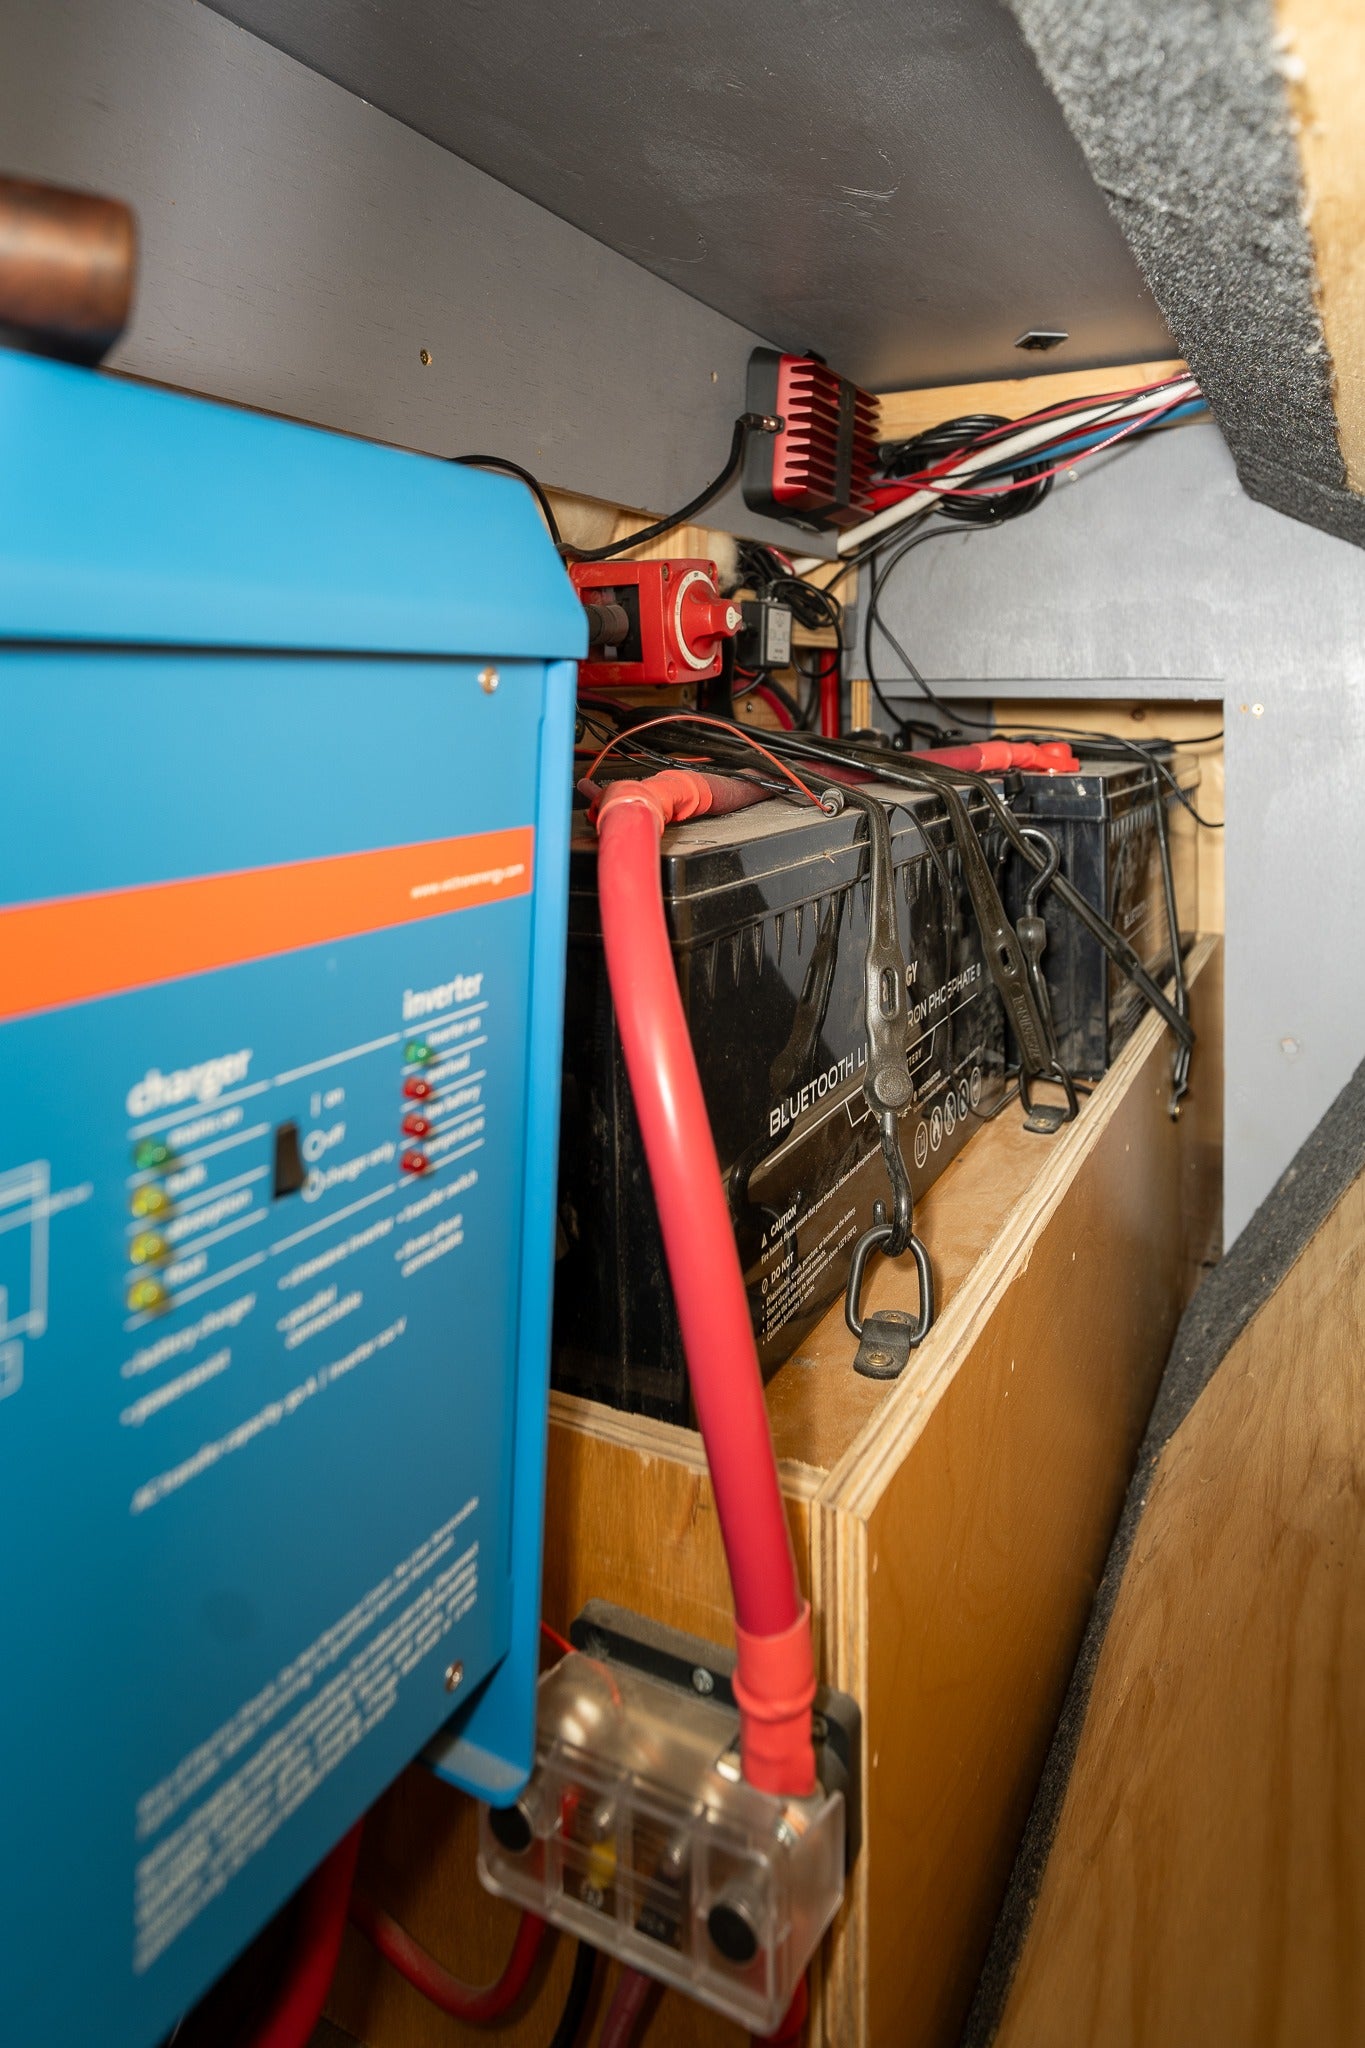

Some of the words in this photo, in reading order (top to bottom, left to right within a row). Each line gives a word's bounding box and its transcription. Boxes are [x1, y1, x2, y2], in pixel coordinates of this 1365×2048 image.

[906, 999, 927, 1027] RON
[126, 1048, 253, 1118] charger
[769, 1052, 854, 1137] BLUETOOTH
[771, 1204, 797, 1237] CAUTION
[771, 1266, 781, 1284] DO
[781, 1251, 794, 1273] NOT
